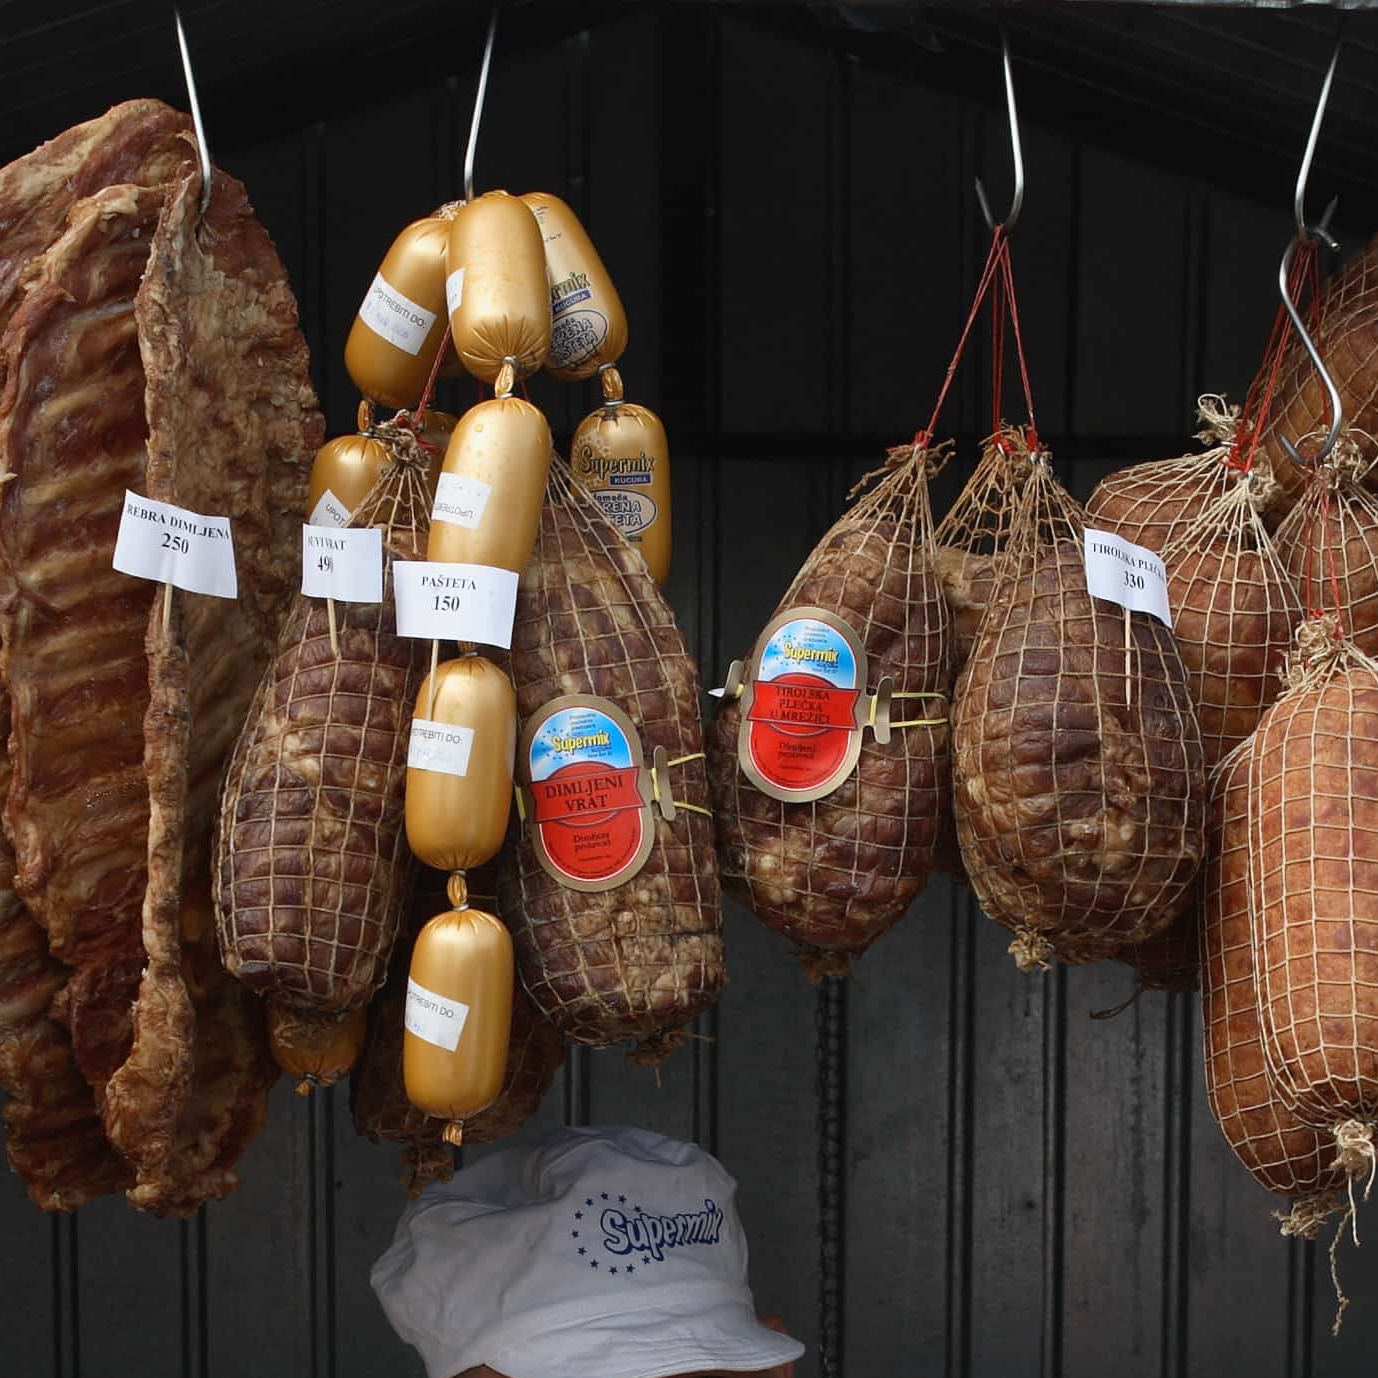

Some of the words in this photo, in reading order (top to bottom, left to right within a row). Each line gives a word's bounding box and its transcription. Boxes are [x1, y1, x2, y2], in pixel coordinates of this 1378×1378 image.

[579, 446, 656, 482] Supermix
[127, 503, 167, 525] REBRA
[169, 516, 231, 542] DIMLJENA
[161, 532, 190, 555] 250
[421, 573, 477, 592] PAŠTETA
[1124, 570, 1145, 590] 330
[433, 595, 461, 613] 150
[782, 641, 840, 665] Supermix
[445, 733, 464, 745] DO:
[552, 728, 610, 756] Supermix
[544, 773, 625, 800] DIMLJENI
[563, 794, 609, 813] VRAT
[599, 1198, 725, 1262] Supermix
